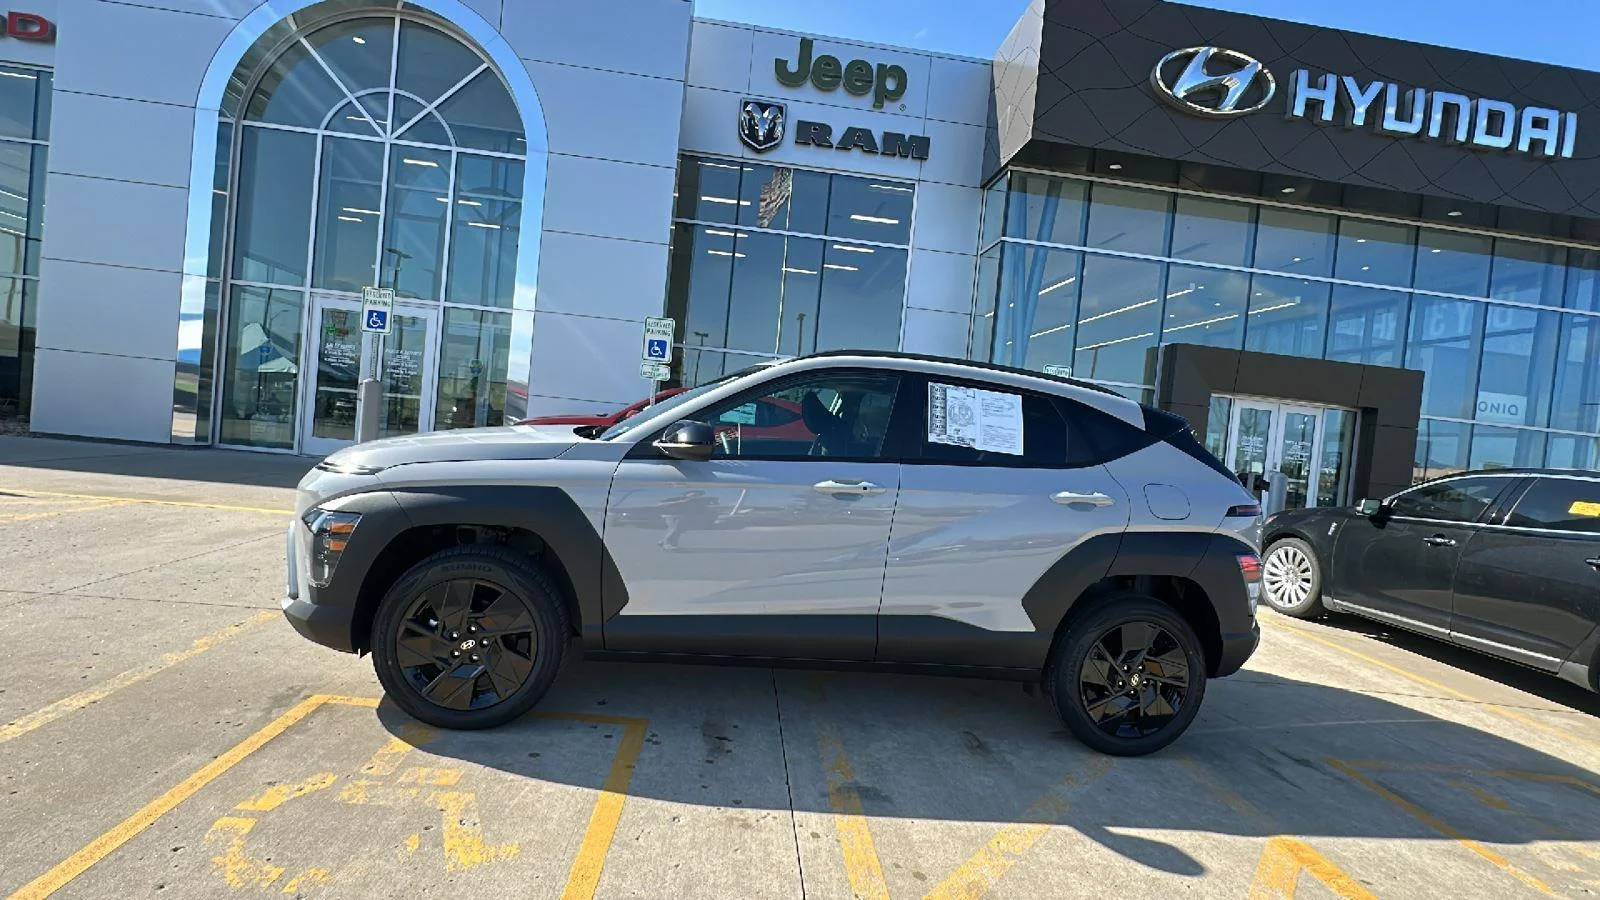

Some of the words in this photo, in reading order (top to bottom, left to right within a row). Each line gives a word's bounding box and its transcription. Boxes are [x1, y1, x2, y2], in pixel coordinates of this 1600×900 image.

[775, 37, 908, 110] Jeep
[1287, 68, 1578, 159] HYUNDAI
[794, 119, 931, 161] RAM
[365, 298, 391, 307] PARKING
[646, 328, 671, 336] PARKING
[1478, 401, 1518, 416] ONIQ
